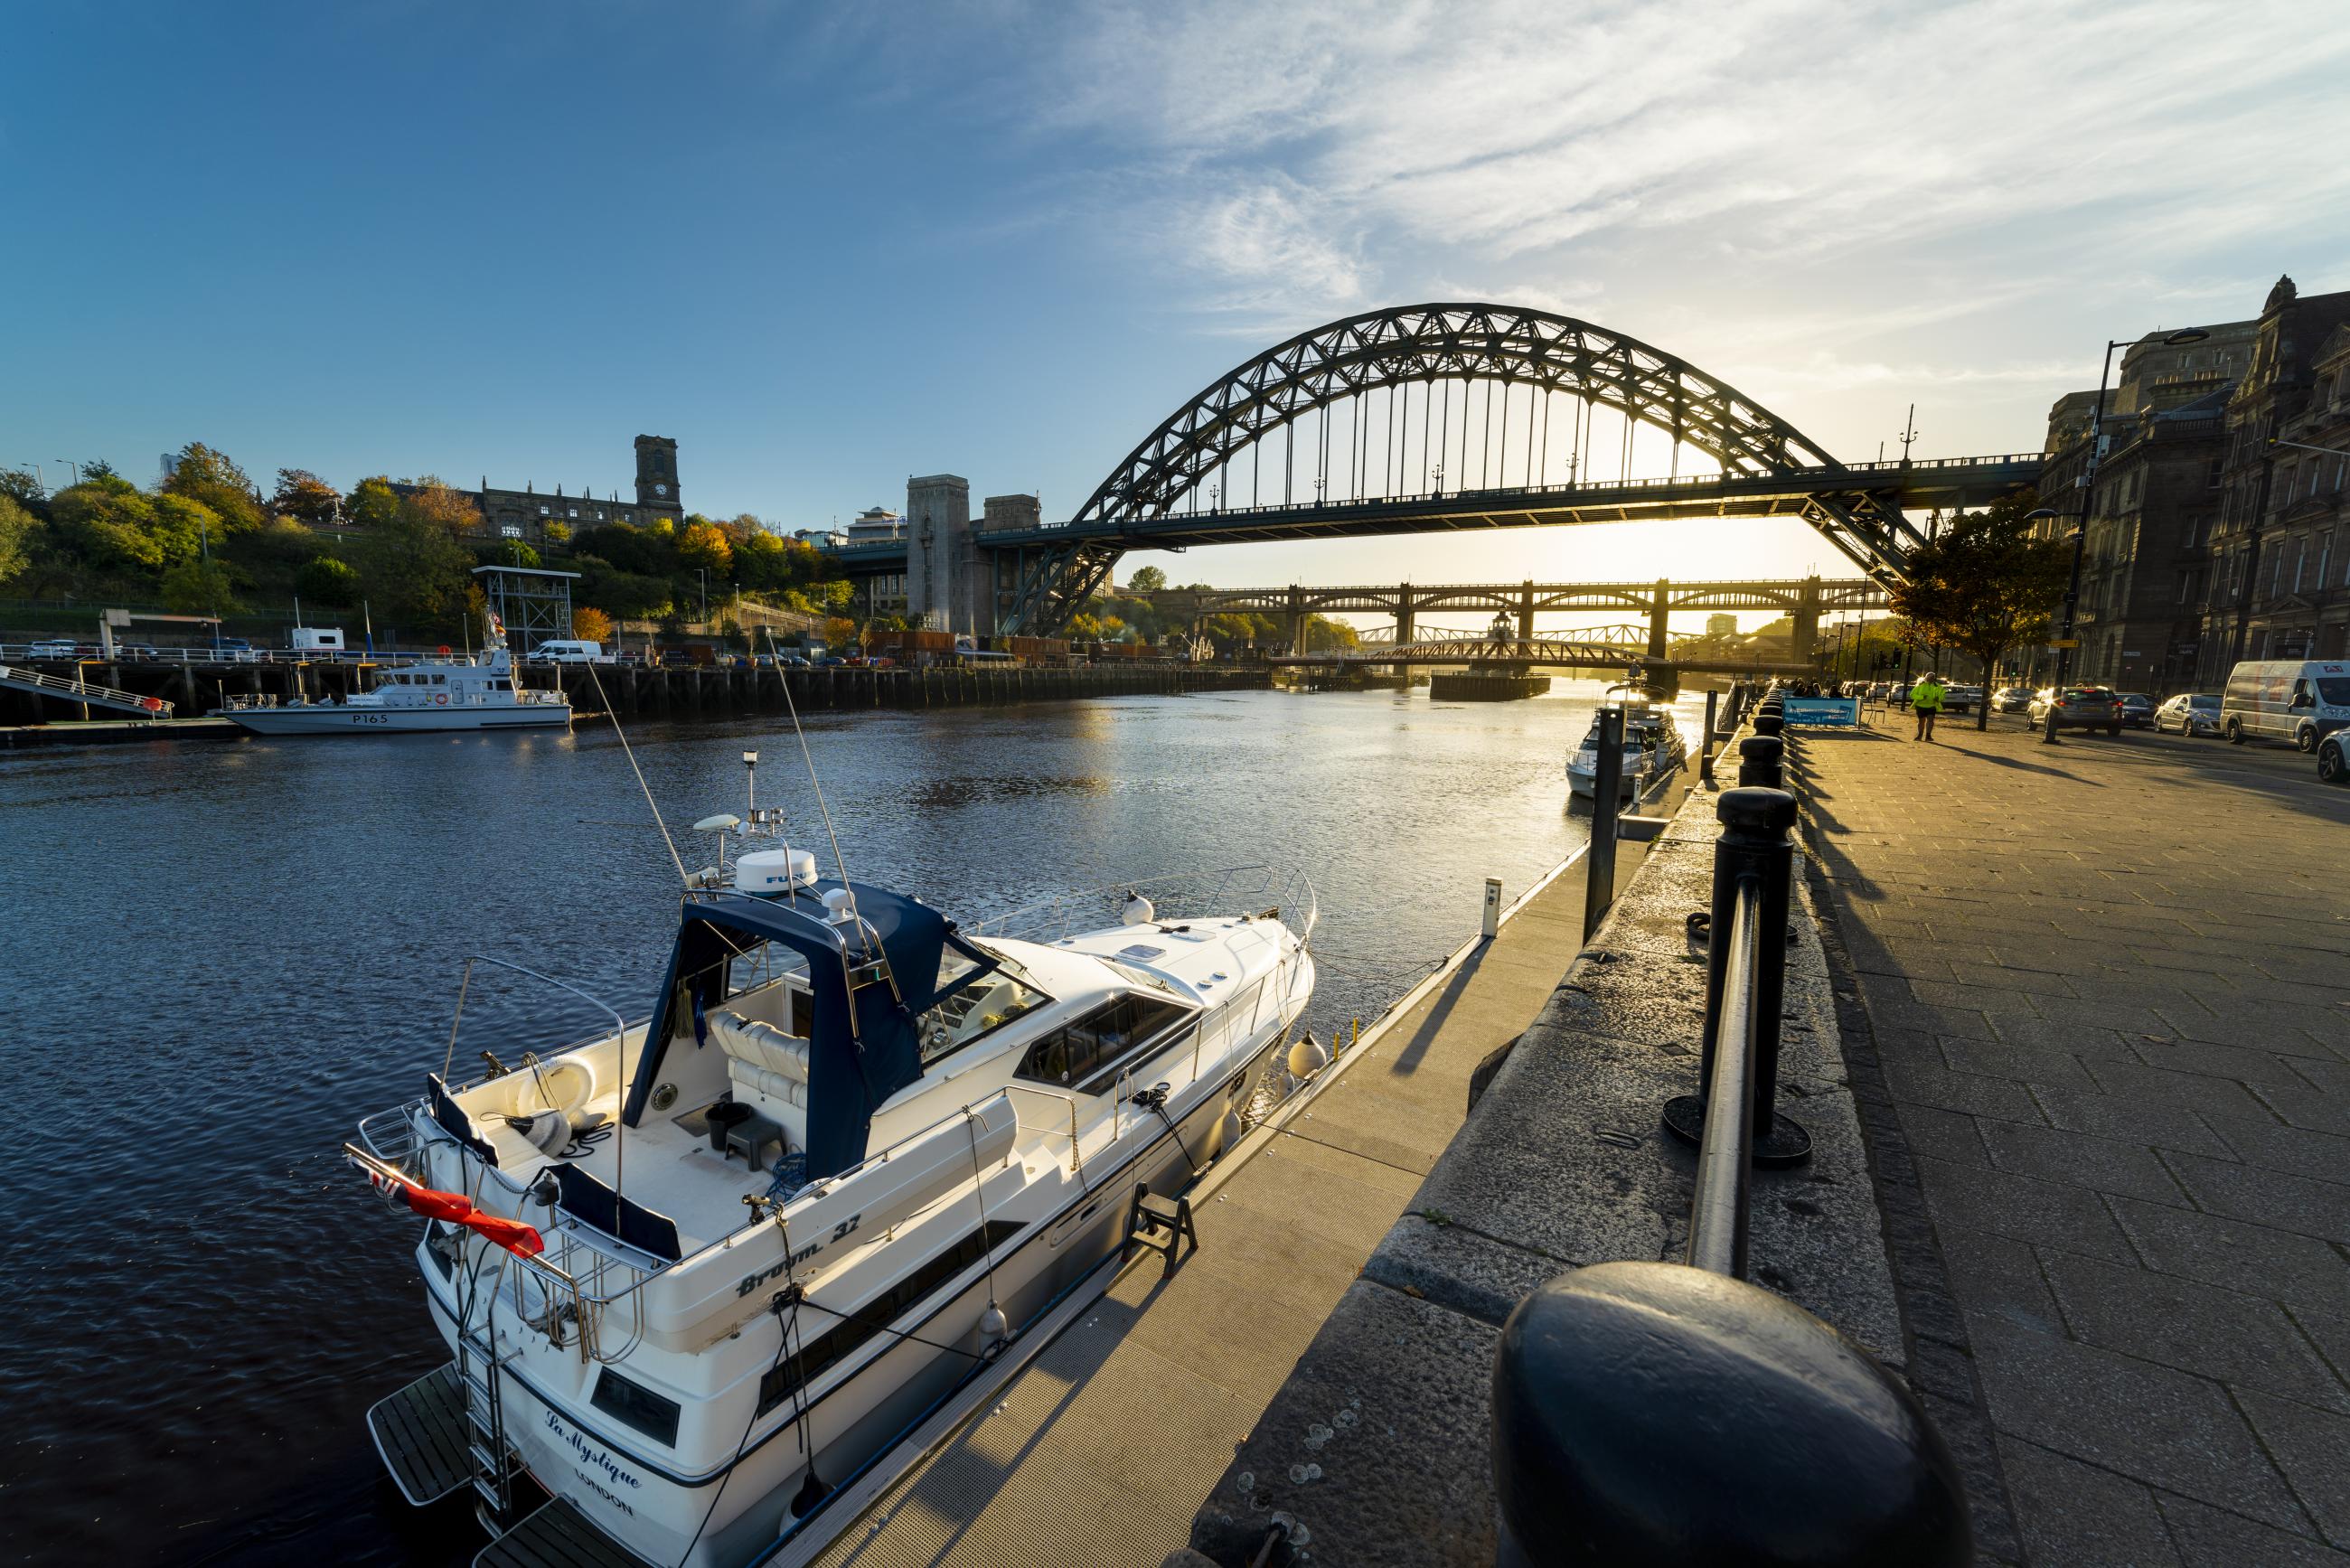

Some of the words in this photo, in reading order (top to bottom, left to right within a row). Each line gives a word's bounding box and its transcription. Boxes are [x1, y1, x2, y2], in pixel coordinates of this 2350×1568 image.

[353, 715, 388, 724] P165
[566, 1431, 643, 1489] Mystique
[575, 1468, 634, 1517] LONDON
